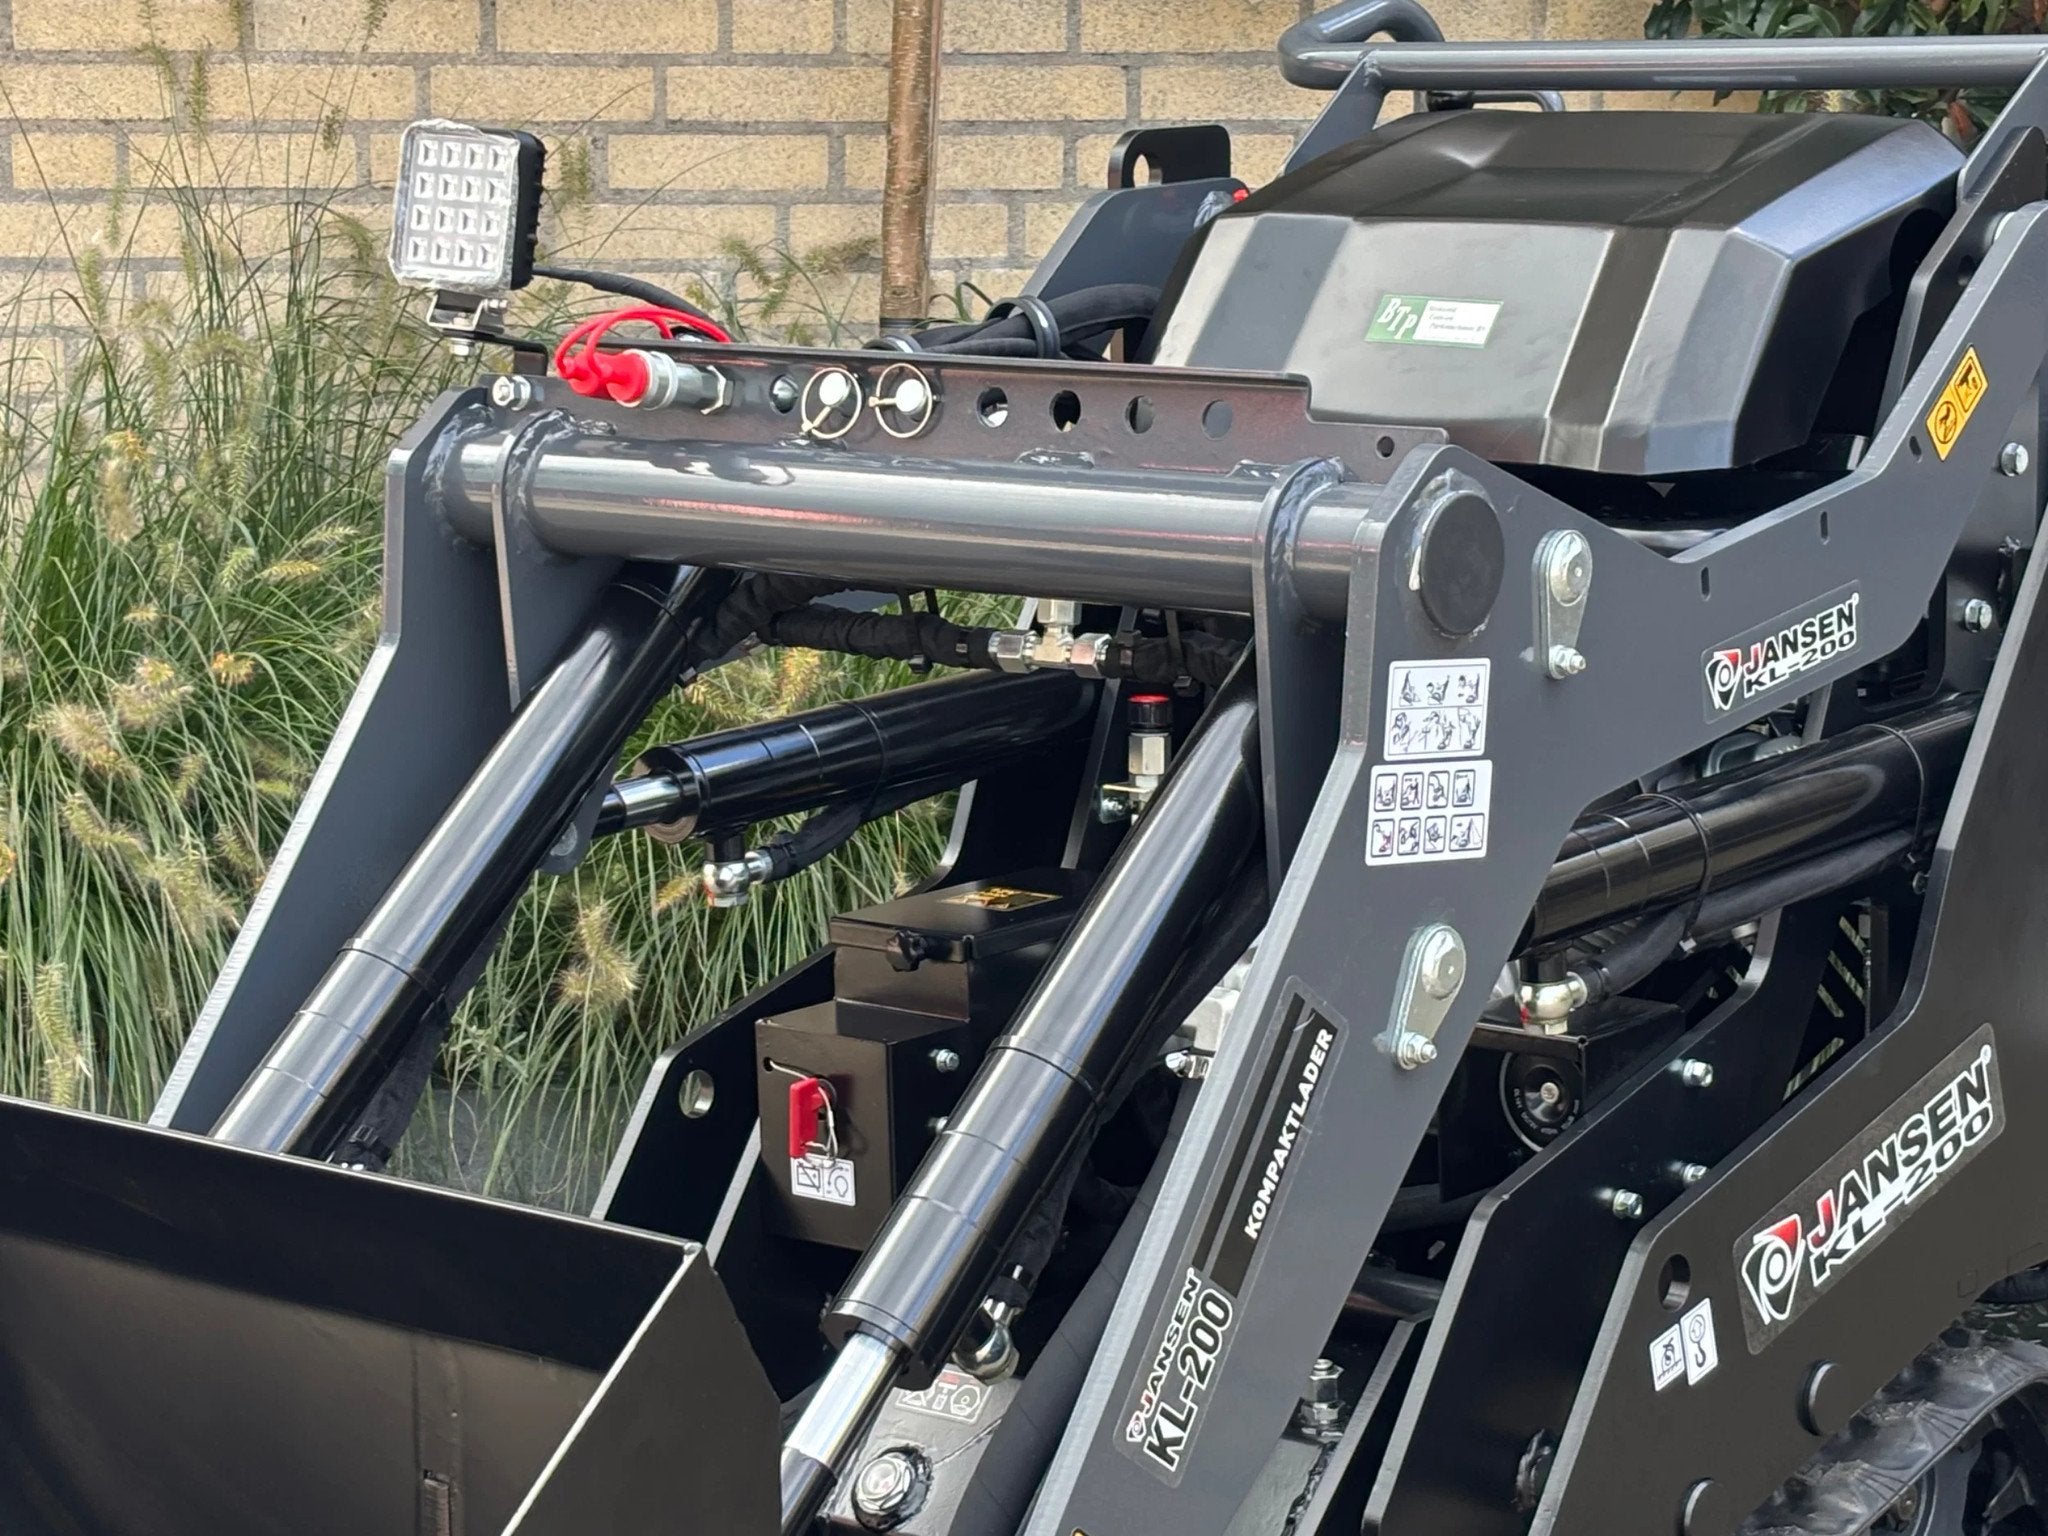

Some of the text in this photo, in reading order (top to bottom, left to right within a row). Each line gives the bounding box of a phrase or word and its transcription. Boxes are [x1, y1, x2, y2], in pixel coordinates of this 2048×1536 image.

[1377, 298, 1418, 340] BTP
[1743, 598, 1857, 677] JANSEN
[1744, 629, 1857, 698] KL-200
[1244, 1028, 1333, 1240] KOMPAKTLADER
[1807, 1060, 1991, 1253] JANSEN
[1810, 1102, 1993, 1287] KL-200
[1141, 1274, 1201, 1418] JANSEN
[1144, 1288, 1233, 1472] KL-200
